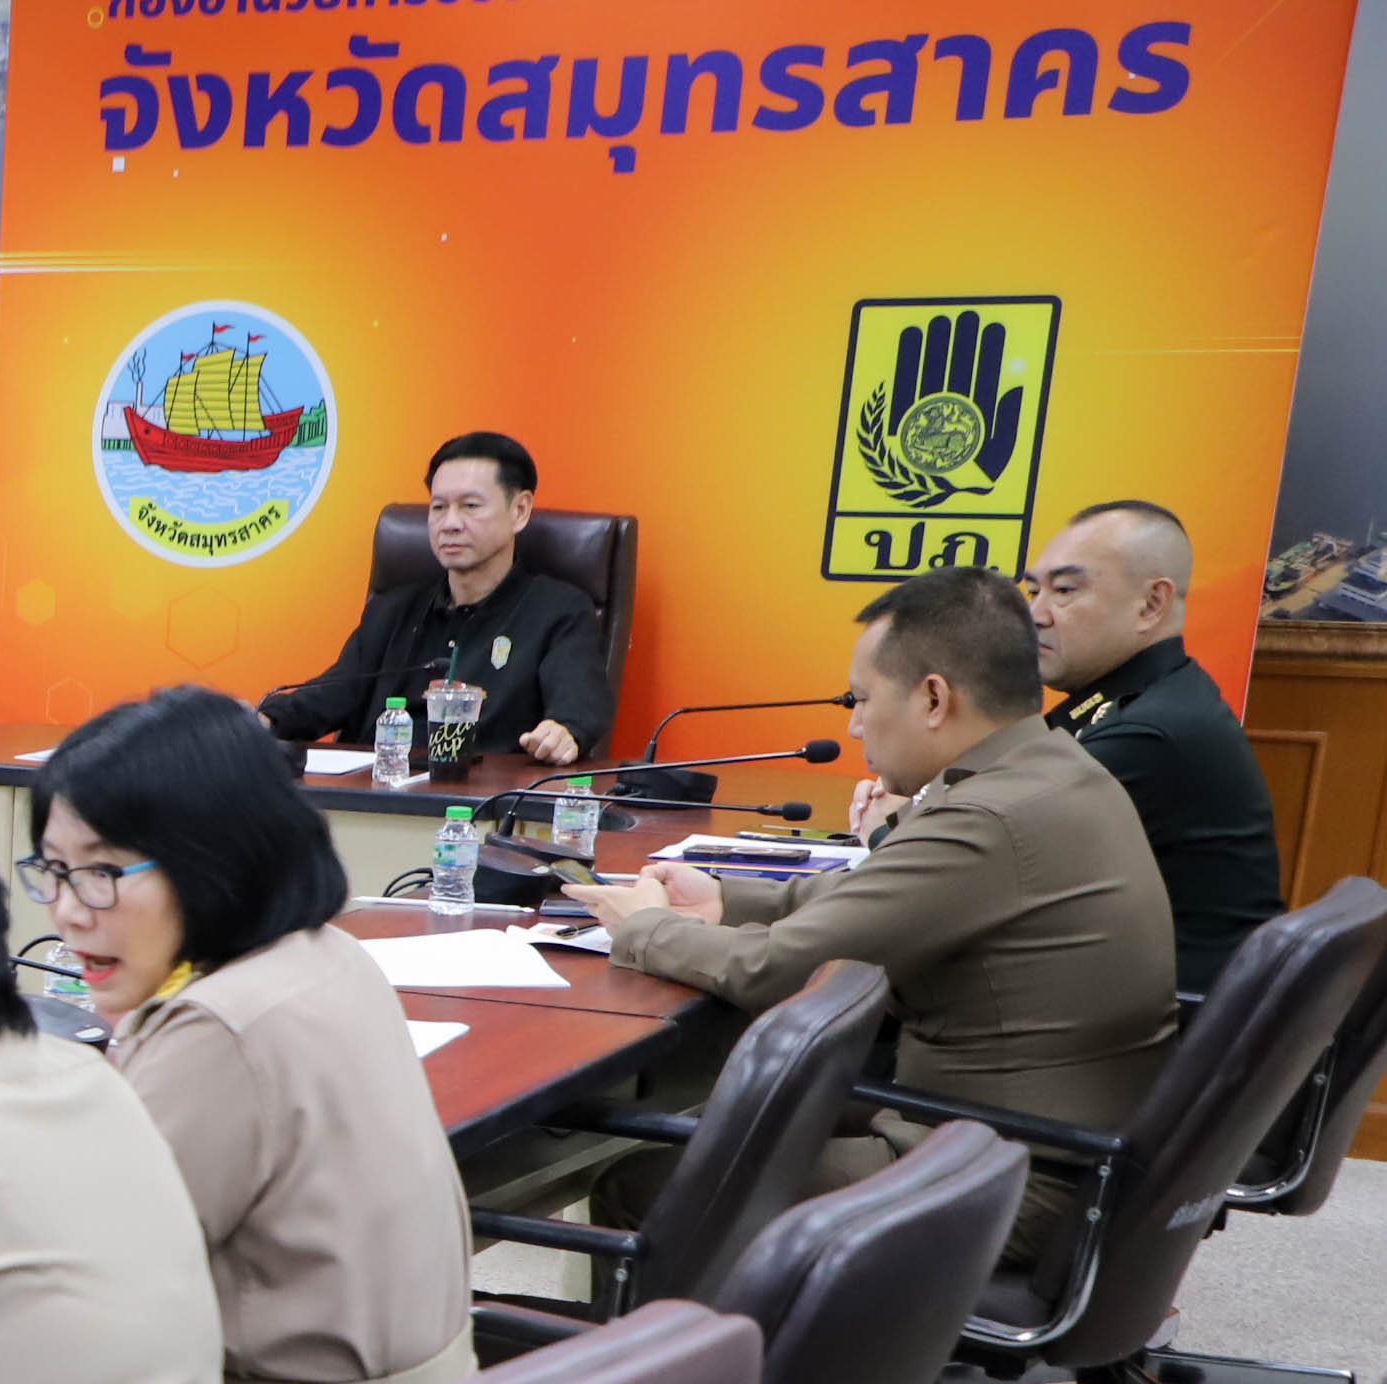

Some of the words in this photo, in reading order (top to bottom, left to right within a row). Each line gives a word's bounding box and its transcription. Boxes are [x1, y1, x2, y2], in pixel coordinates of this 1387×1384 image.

[99, 20, 1192, 174] จังหวัดสมุทรสาคร
[138, 501, 281, 556] จังหวัดสมุทรสาคร
